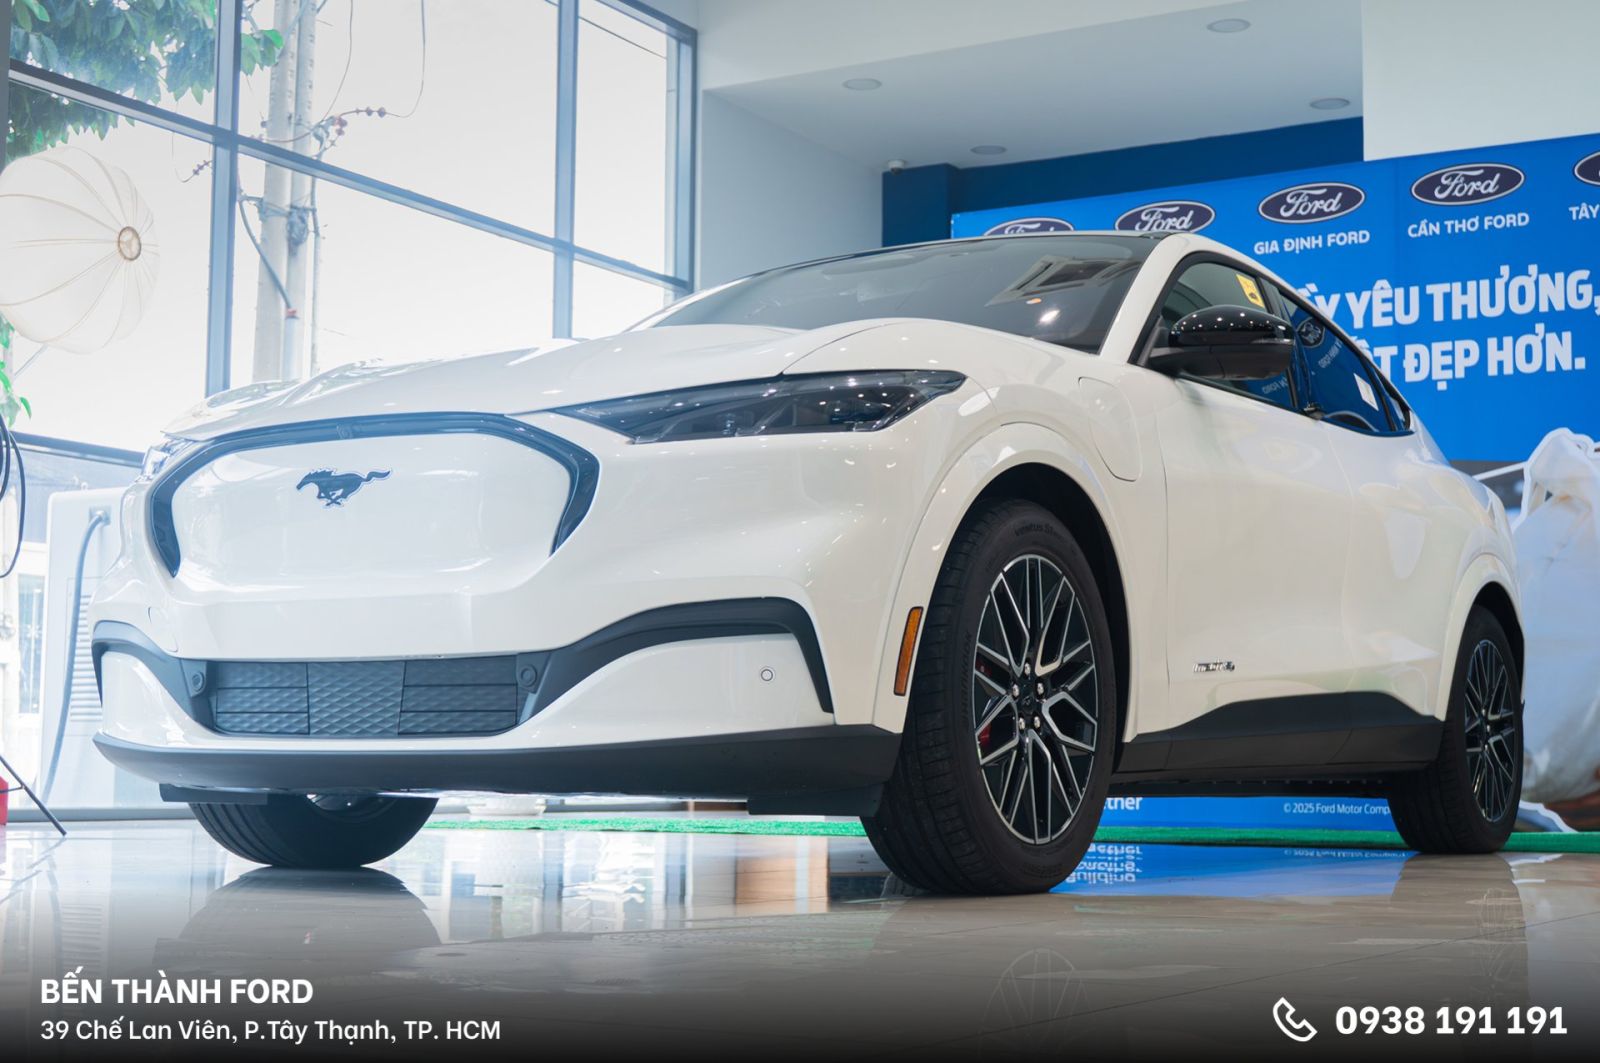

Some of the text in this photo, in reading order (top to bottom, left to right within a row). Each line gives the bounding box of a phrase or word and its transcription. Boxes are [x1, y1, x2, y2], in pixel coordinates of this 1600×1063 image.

[1434, 168, 1501, 200] Ford
[1280, 187, 1342, 218] Ford
[1568, 202, 1600, 221] TÂY
[1135, 206, 1194, 231] Ford
[1444, 216, 1479, 234] THƠ
[1484, 212, 1530, 229] FORD
[1254, 230, 1370, 255] GIA ĐỊNH FORD
[1345, 279, 1420, 329] YÊU
[1425, 264, 1600, 322] THƯƠNG,
[1403, 340, 1480, 391] ĐẸP
[1487, 323, 1586, 376] HƠN.
[1292, 803, 1315, 813] 2025
[1316, 803, 1335, 813] Ford
[1337, 804, 1362, 814] Motor
[1364, 804, 1391, 816] Comp
